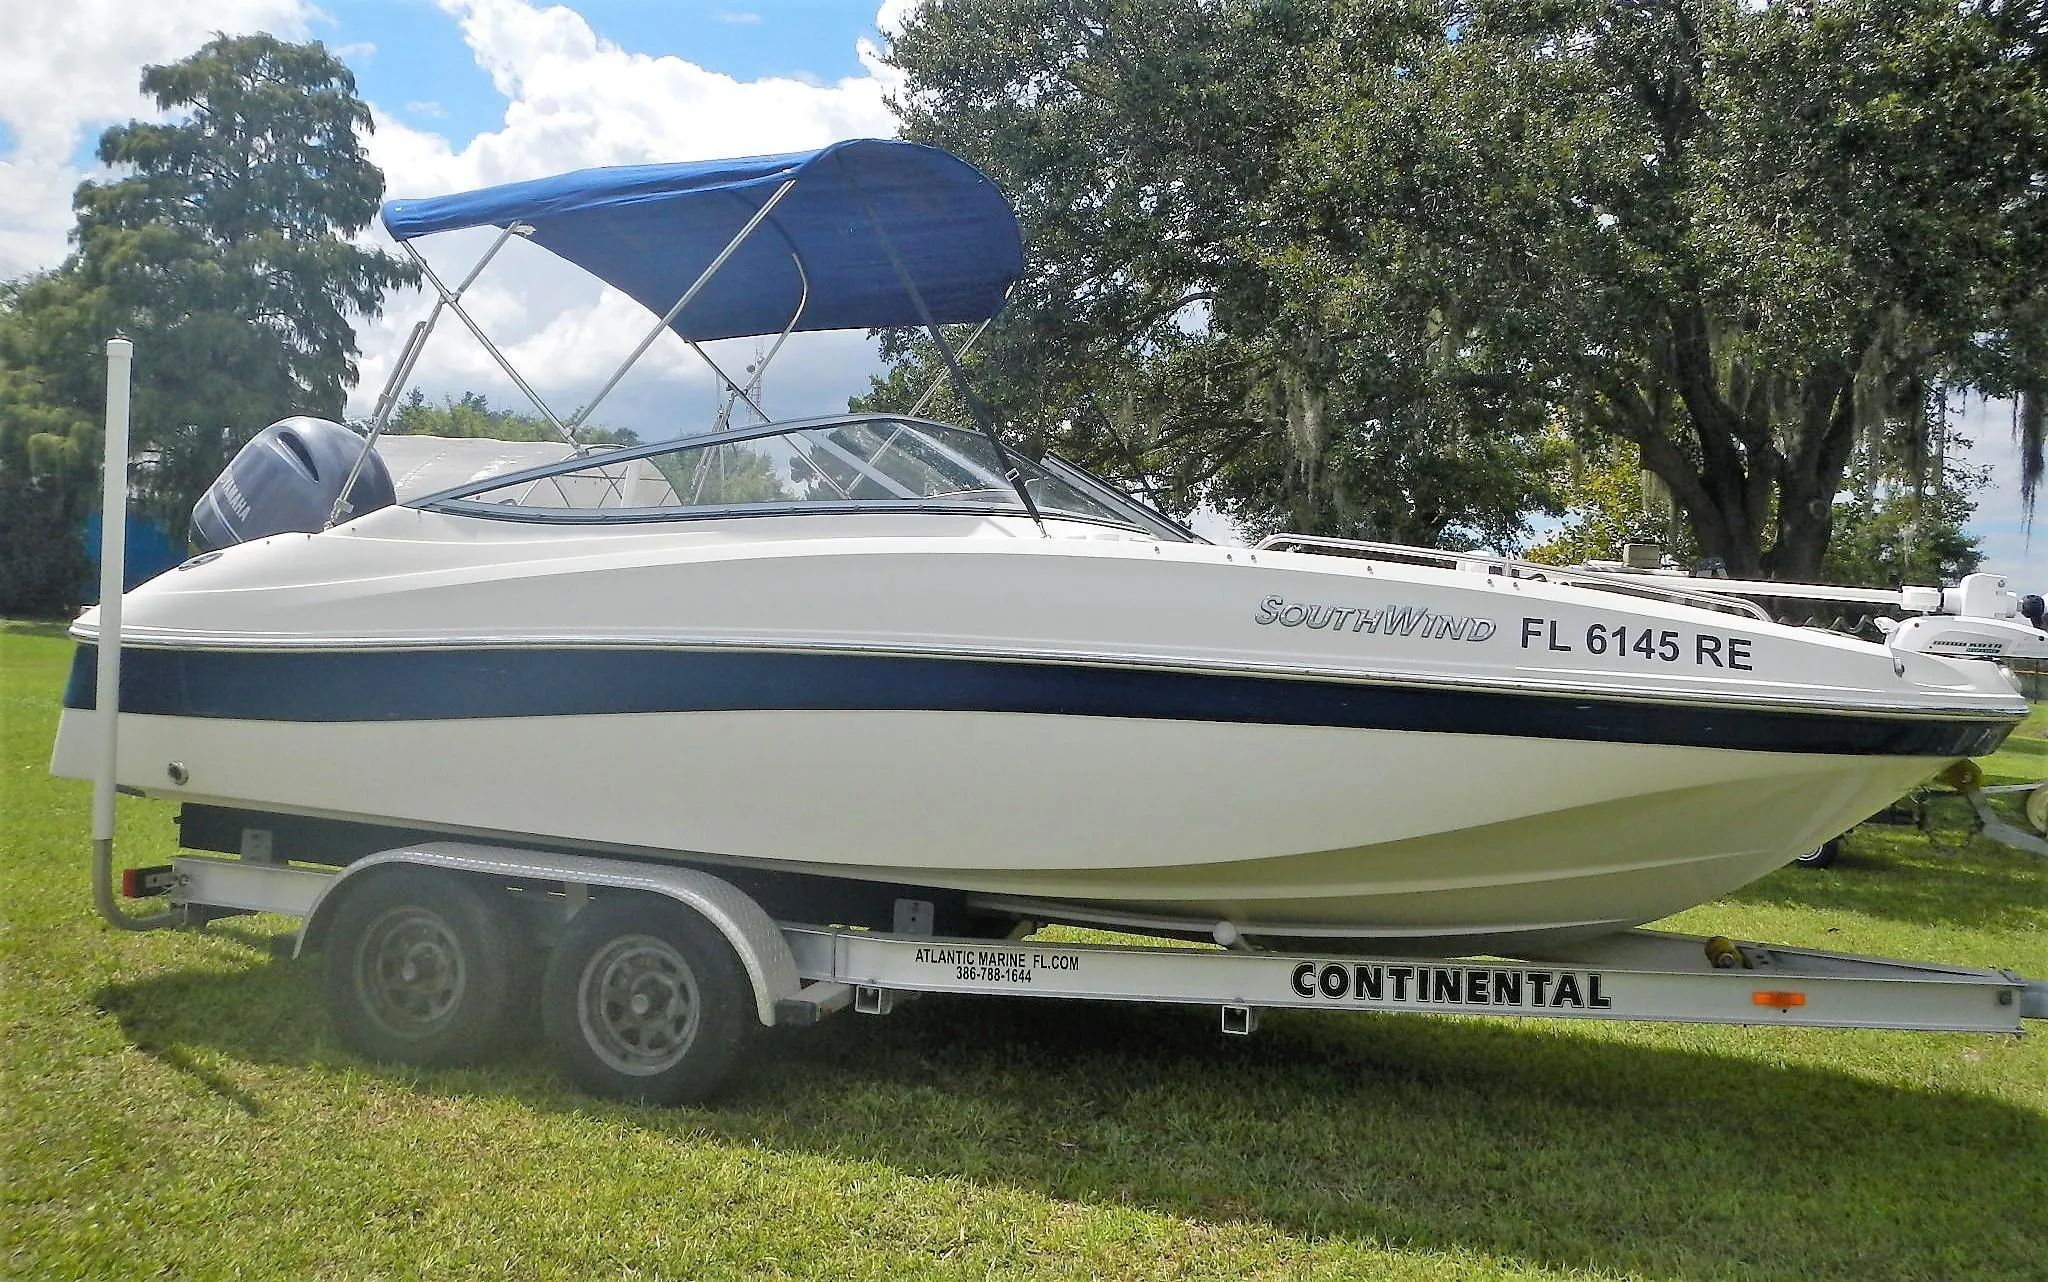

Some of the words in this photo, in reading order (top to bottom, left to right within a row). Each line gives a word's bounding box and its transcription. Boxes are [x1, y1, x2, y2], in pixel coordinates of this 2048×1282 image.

[1520, 617, 1572, 652] FL
[1586, 624, 1681, 662] 6145
[1695, 633, 1754, 672] RE
[915, 948, 975, 966] ATLANTIC
[978, 952, 1026, 968] MARINE
[1033, 954, 1079, 970] FL.COM
[956, 966, 1032, 983] 386-788-1644
[1290, 961, 1612, 1009] CONTINENTAL
